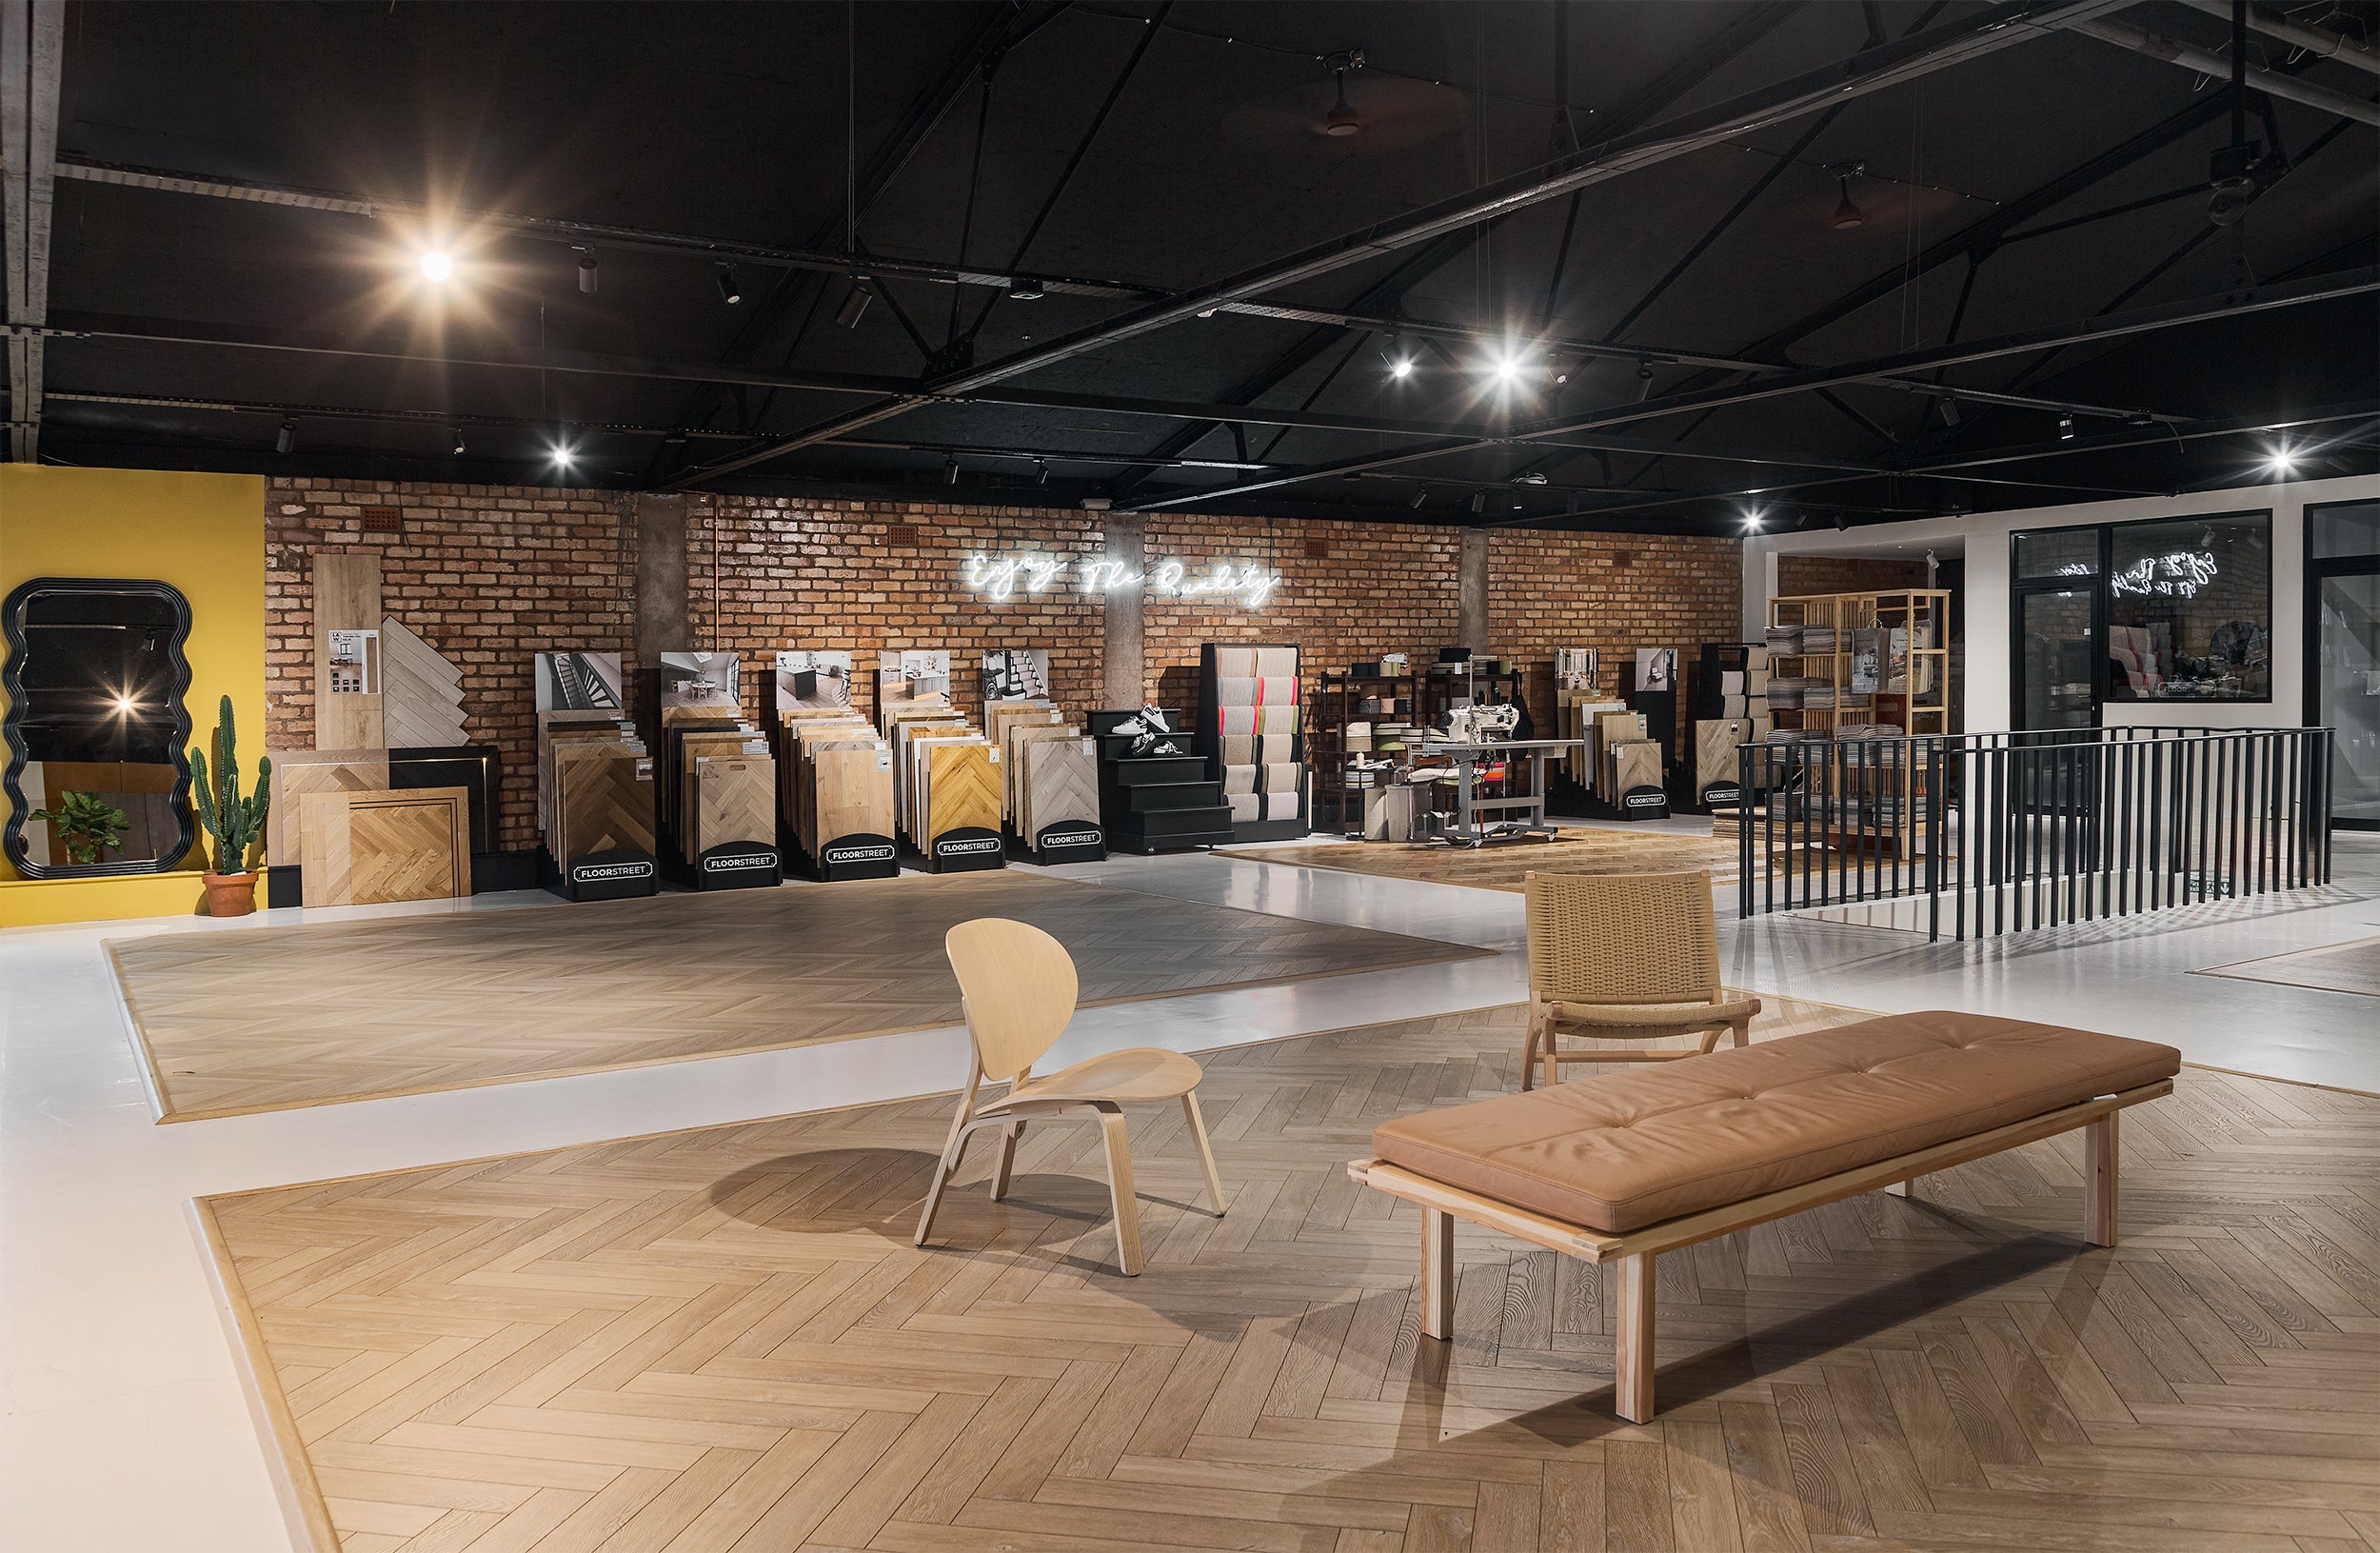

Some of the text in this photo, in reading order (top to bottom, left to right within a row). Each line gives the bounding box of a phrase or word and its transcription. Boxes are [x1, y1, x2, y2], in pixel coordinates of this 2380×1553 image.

[969, 554, 1281, 607] Enjoy The Quality
[1047, 834, 1096, 846] FLOORSTREET
[942, 841, 995, 853] FLOORSTREET
[832, 848, 889, 861] FLOORSTREET
[710, 856, 771, 868] FLOORSTREET
[581, 866, 645, 879] FLOORSTREET
